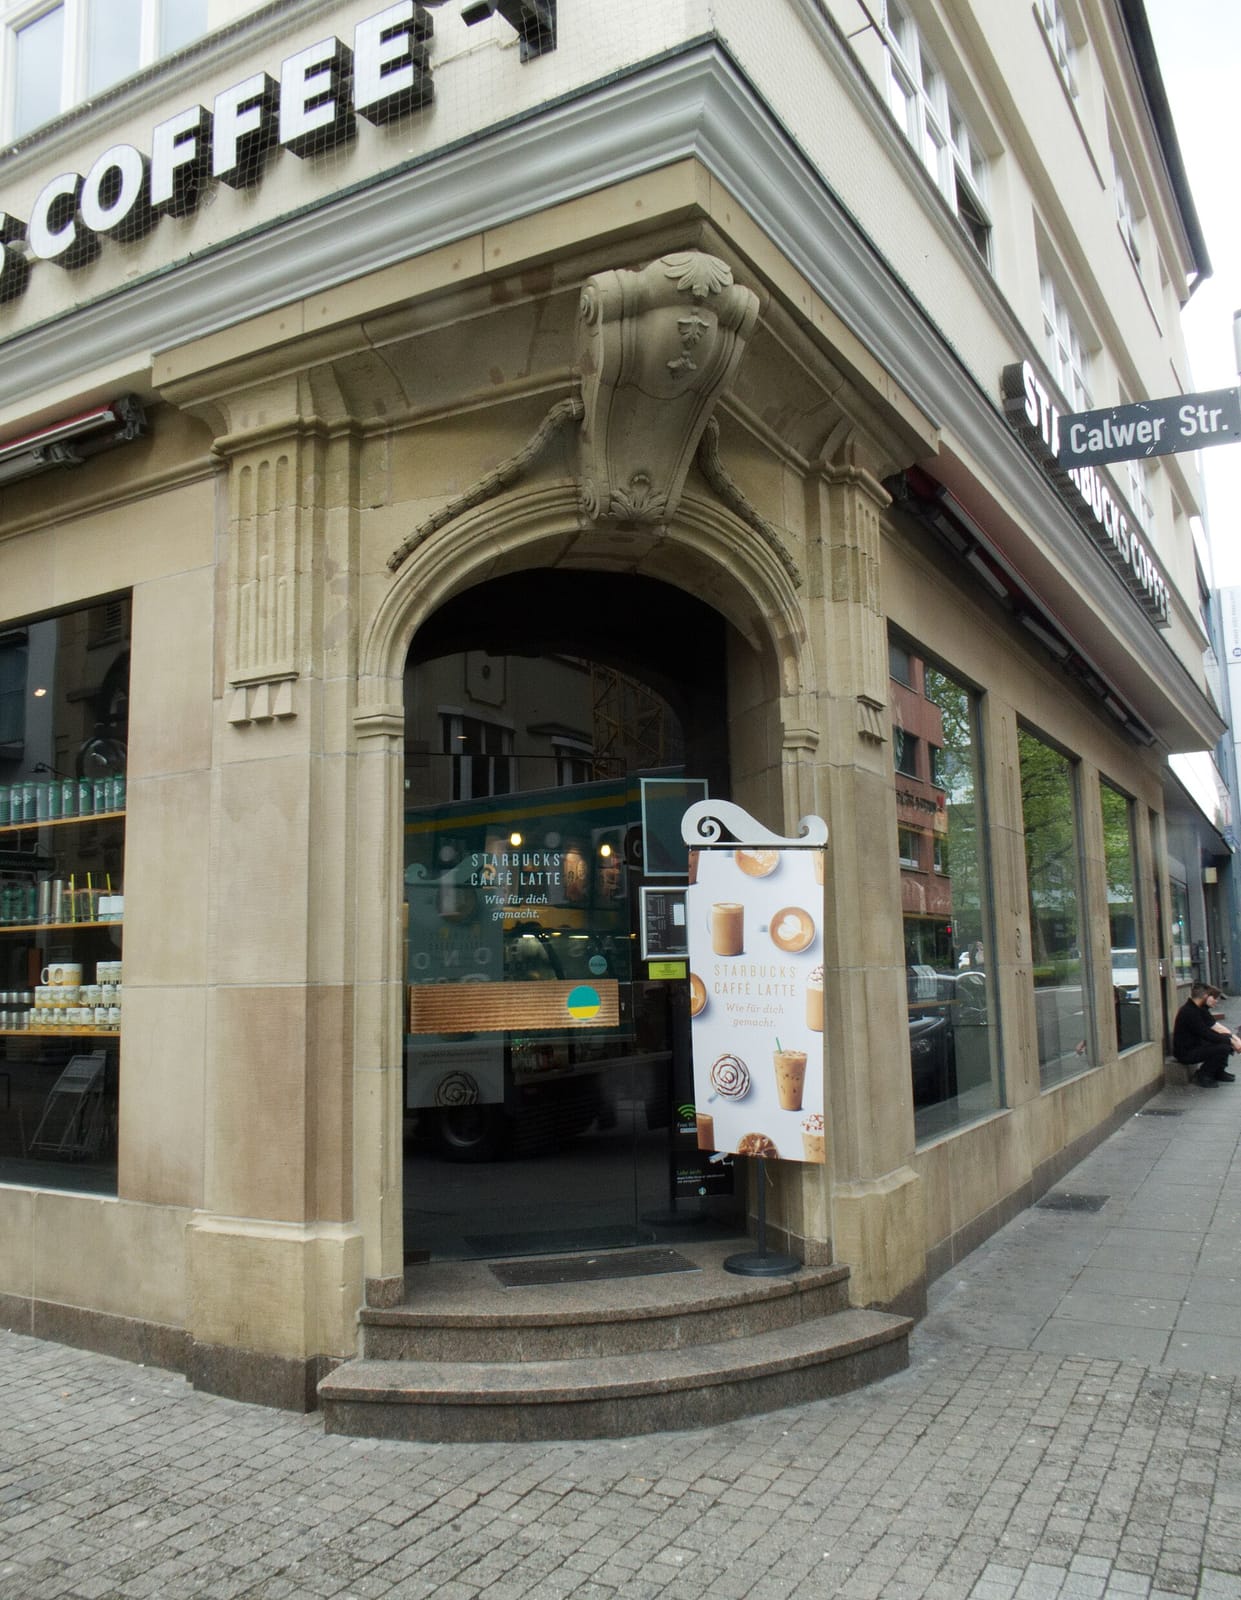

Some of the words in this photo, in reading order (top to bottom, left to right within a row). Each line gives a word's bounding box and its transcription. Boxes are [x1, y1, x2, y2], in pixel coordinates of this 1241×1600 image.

[28, 0, 415, 260] COFFEE
[1070, 417, 1166, 454] Calwer
[1178, 404, 1229, 437] Str.
[471, 853, 560, 867] STARBUCKS
[470, 870, 513, 886] CAFFÈ
[520, 871, 561, 886] LATTE
[484, 894, 505, 905] Wie
[506, 894, 524, 906] für
[525, 893, 548, 904] dich
[492, 908, 540, 921] gemacht.
[713, 963, 796, 978] STARBUCKS
[758, 983, 796, 997] LATTE
